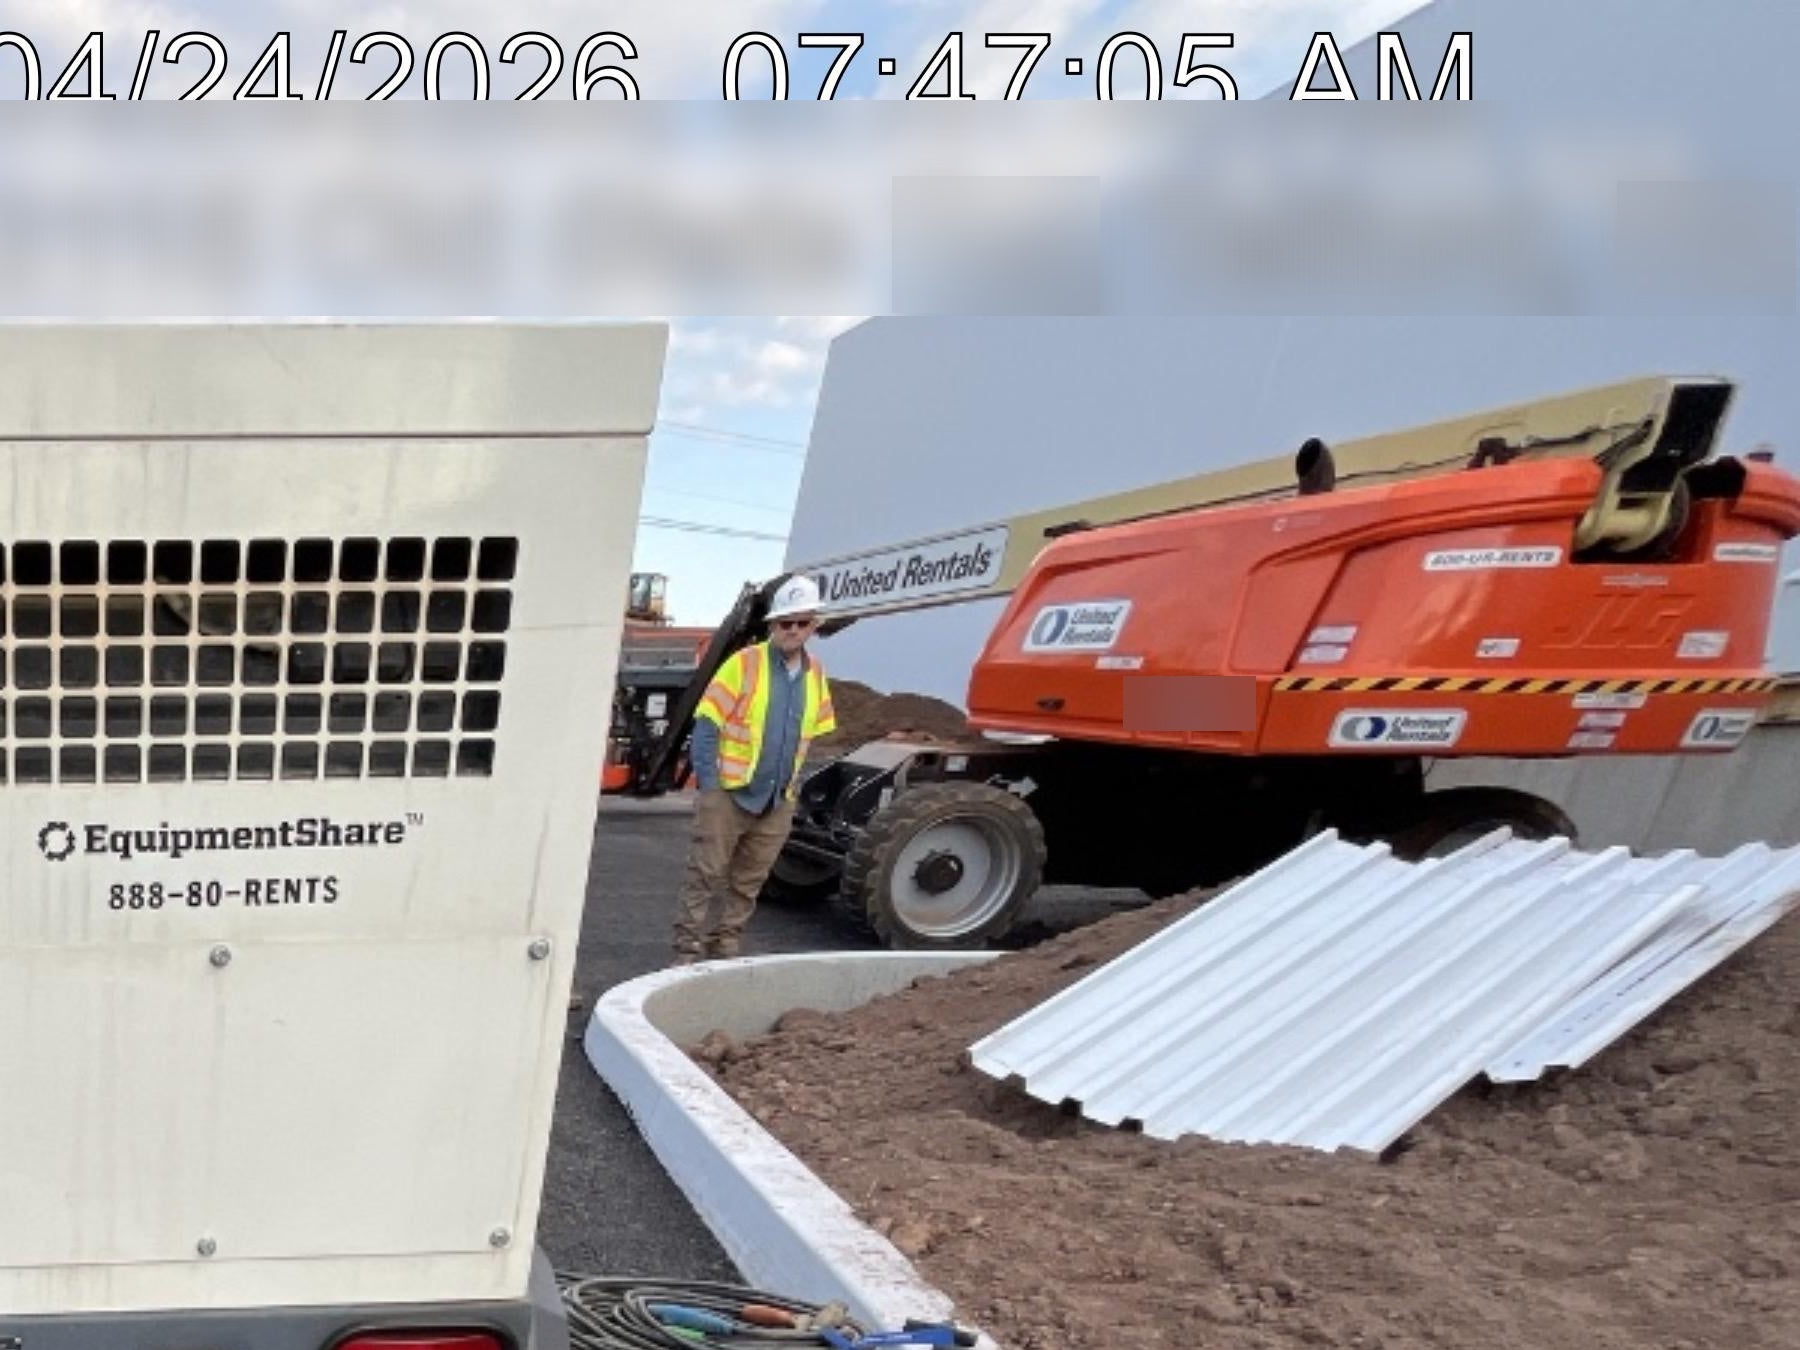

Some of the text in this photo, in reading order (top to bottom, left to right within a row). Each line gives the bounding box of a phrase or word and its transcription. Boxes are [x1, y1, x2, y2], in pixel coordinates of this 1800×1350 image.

[830, 542, 993, 600] United Rentals
[108, 875, 340, 910] 888-80-RENTS
